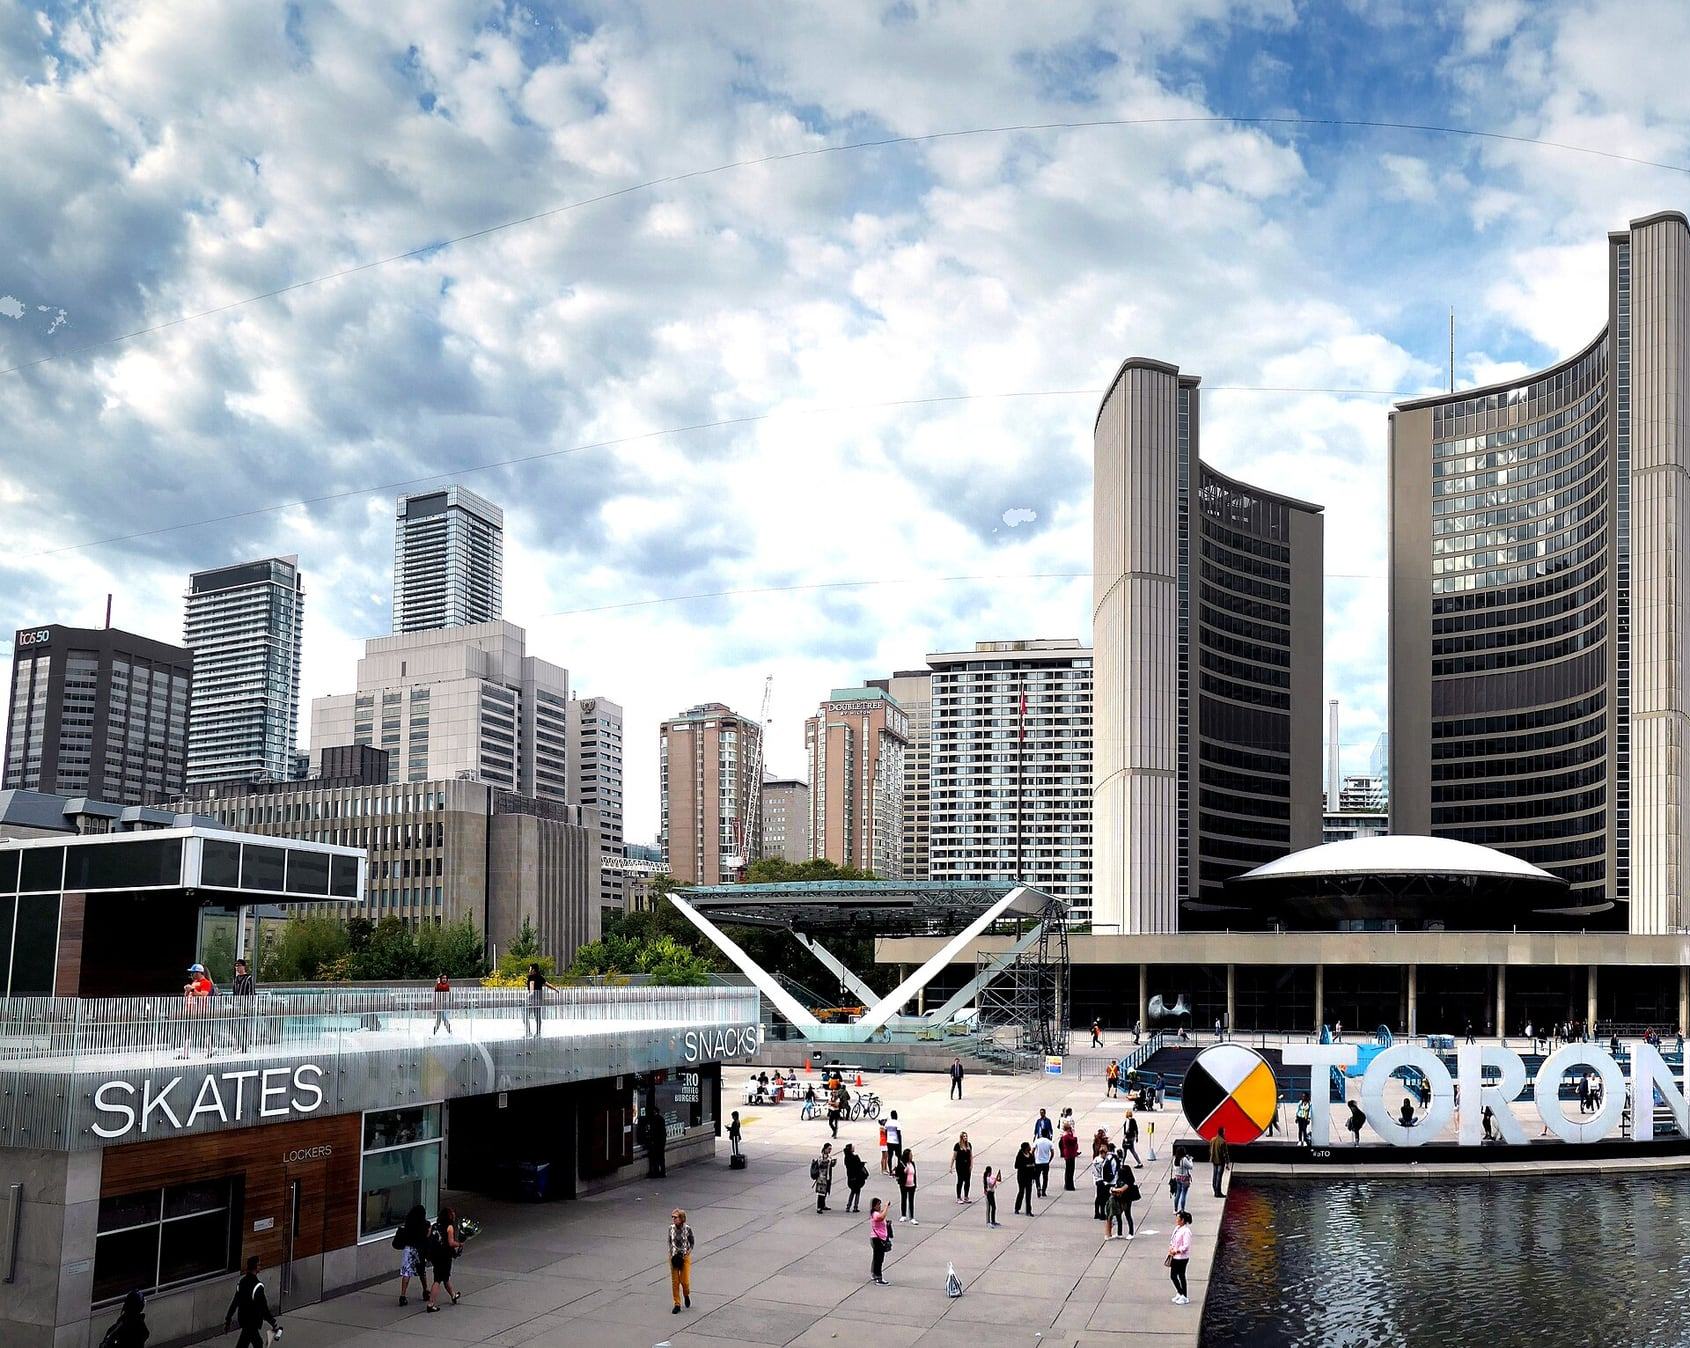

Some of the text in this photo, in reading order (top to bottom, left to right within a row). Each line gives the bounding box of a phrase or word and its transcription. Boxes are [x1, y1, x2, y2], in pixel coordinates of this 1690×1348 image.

[684, 1026, 757, 1062] SNACKS
[91, 1064, 323, 1138] SKATES
[674, 1094, 699, 1102] BURGERS
[283, 1145, 332, 1163] LOCKERS
